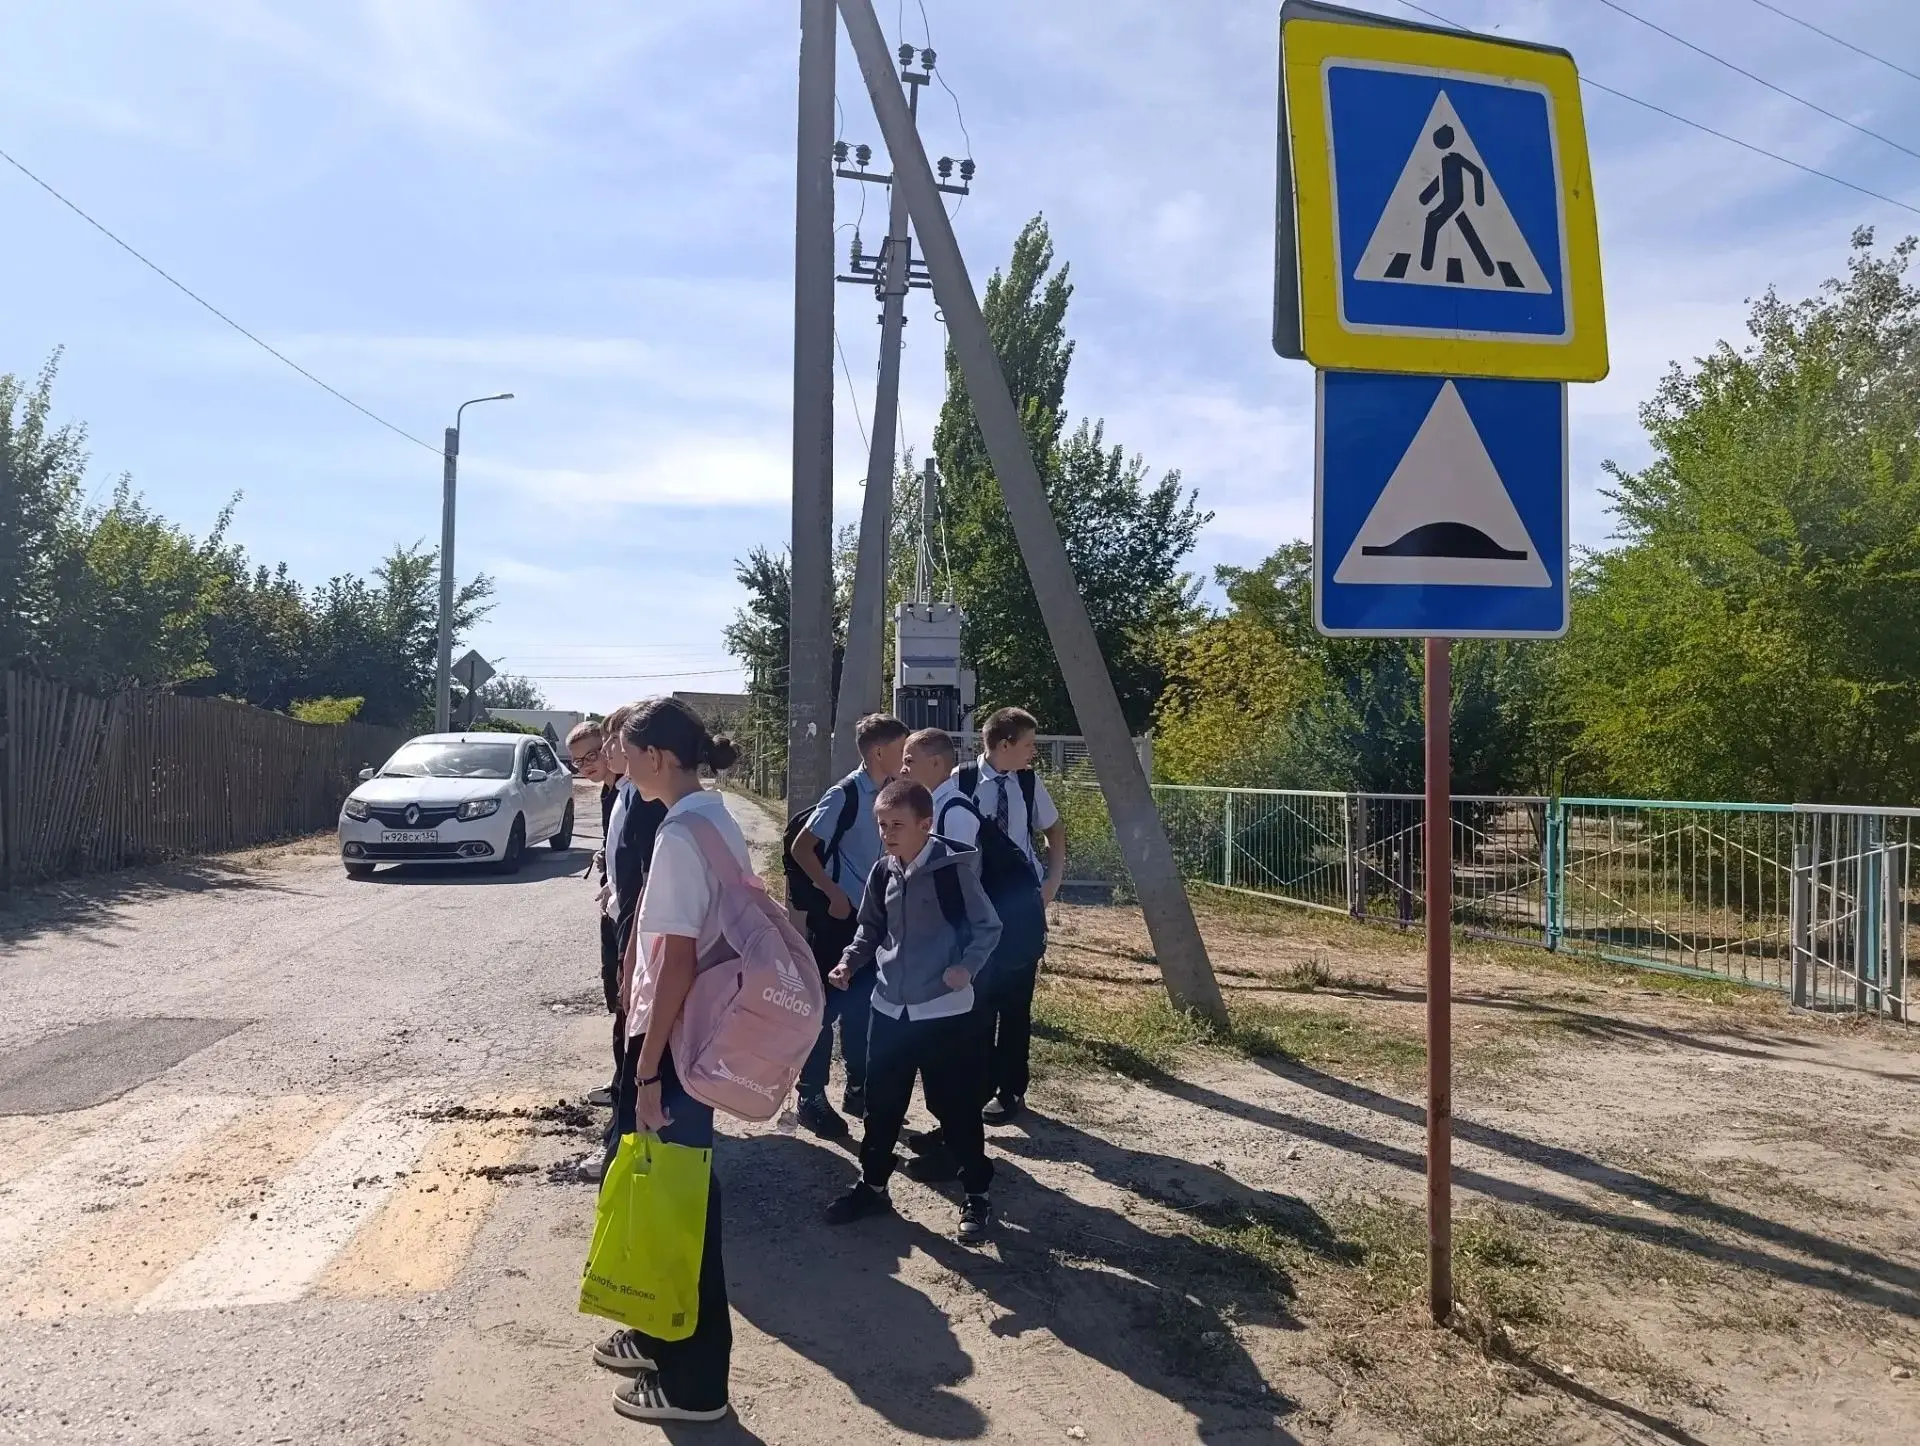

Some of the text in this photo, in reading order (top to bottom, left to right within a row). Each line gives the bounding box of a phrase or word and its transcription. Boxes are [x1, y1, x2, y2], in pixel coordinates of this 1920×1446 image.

[763, 987, 812, 1017] adidas
[732, 1075, 764, 1093] adidas
[620, 1285, 656, 1300] Яблоко
